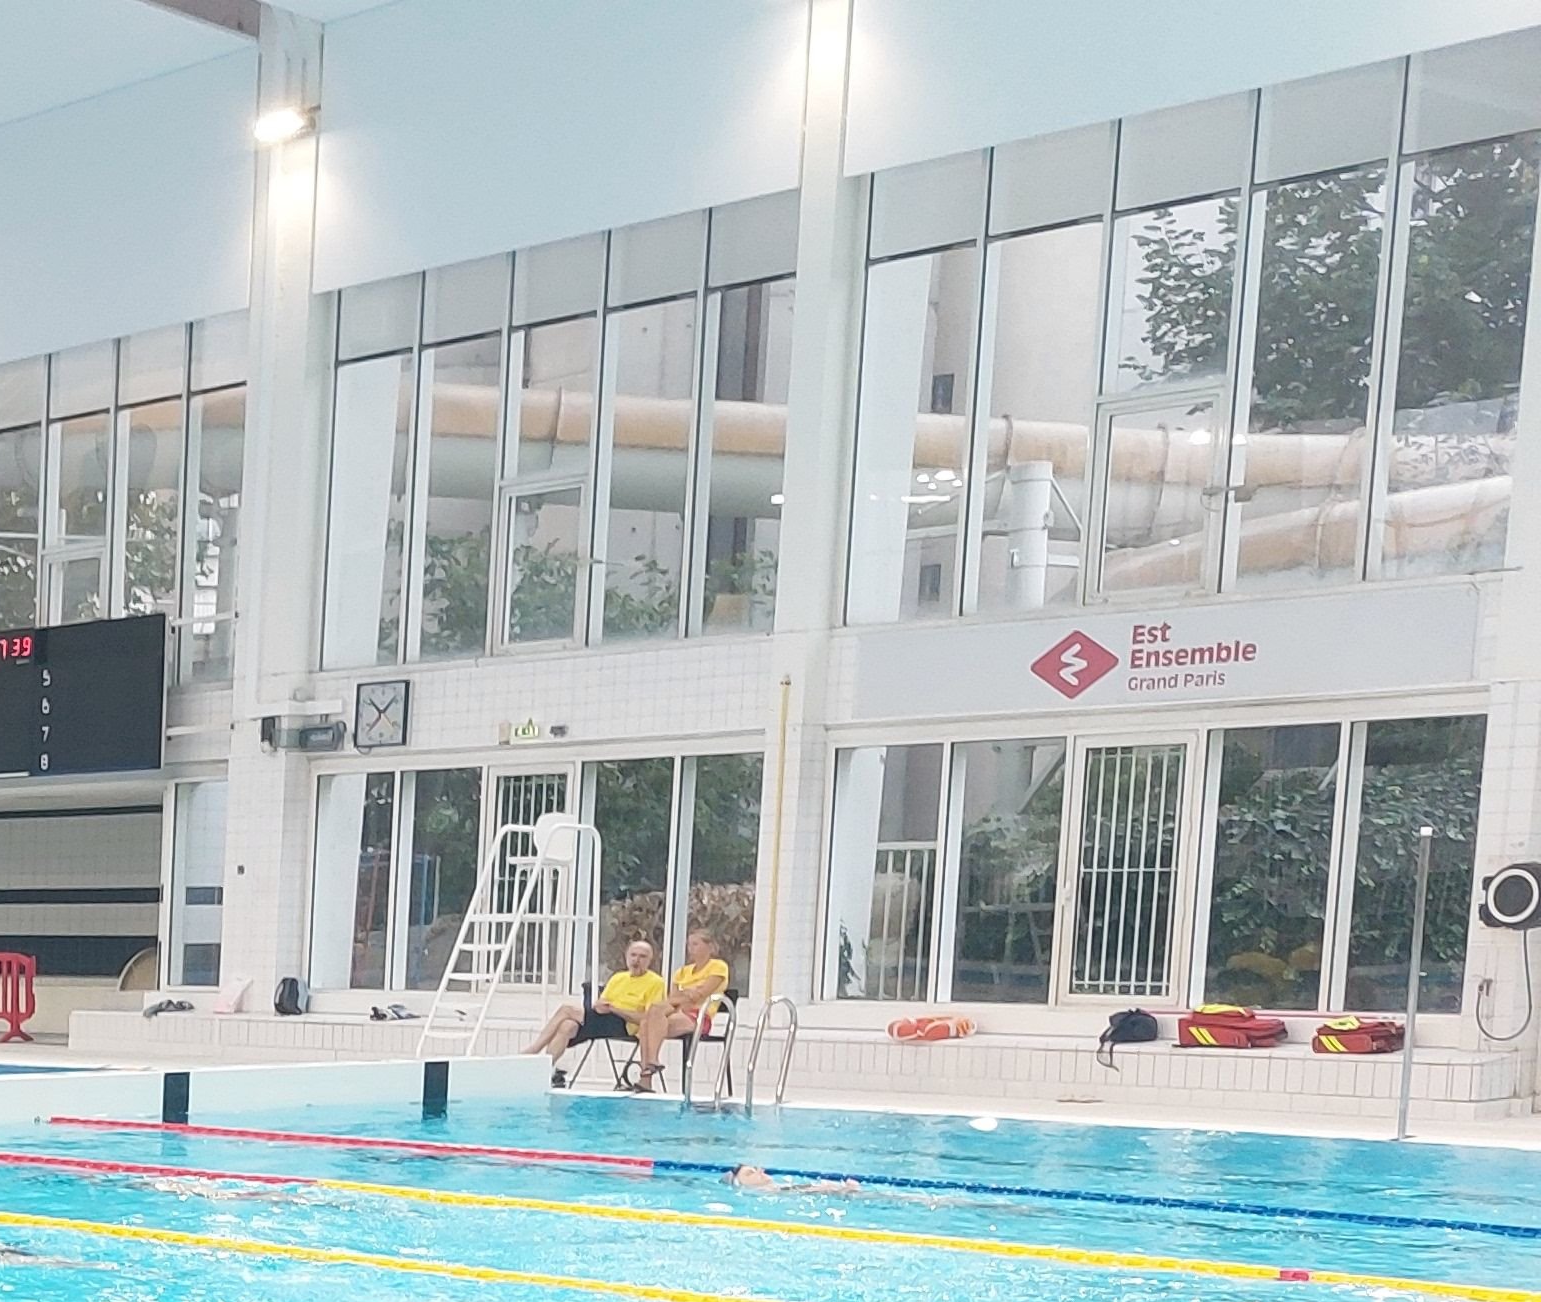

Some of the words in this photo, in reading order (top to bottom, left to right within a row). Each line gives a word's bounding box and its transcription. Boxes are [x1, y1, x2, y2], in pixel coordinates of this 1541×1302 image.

[1132, 622, 1171, 644] Est
[1129, 640, 1257, 668] Ensemble
[42, 669, 51, 686] 5
[1127, 674, 1178, 692] Grand
[1183, 670, 1226, 688] Paris
[41, 698, 50, 714] 6
[41, 726, 49, 742] 7
[40, 753, 49, 770] 8
